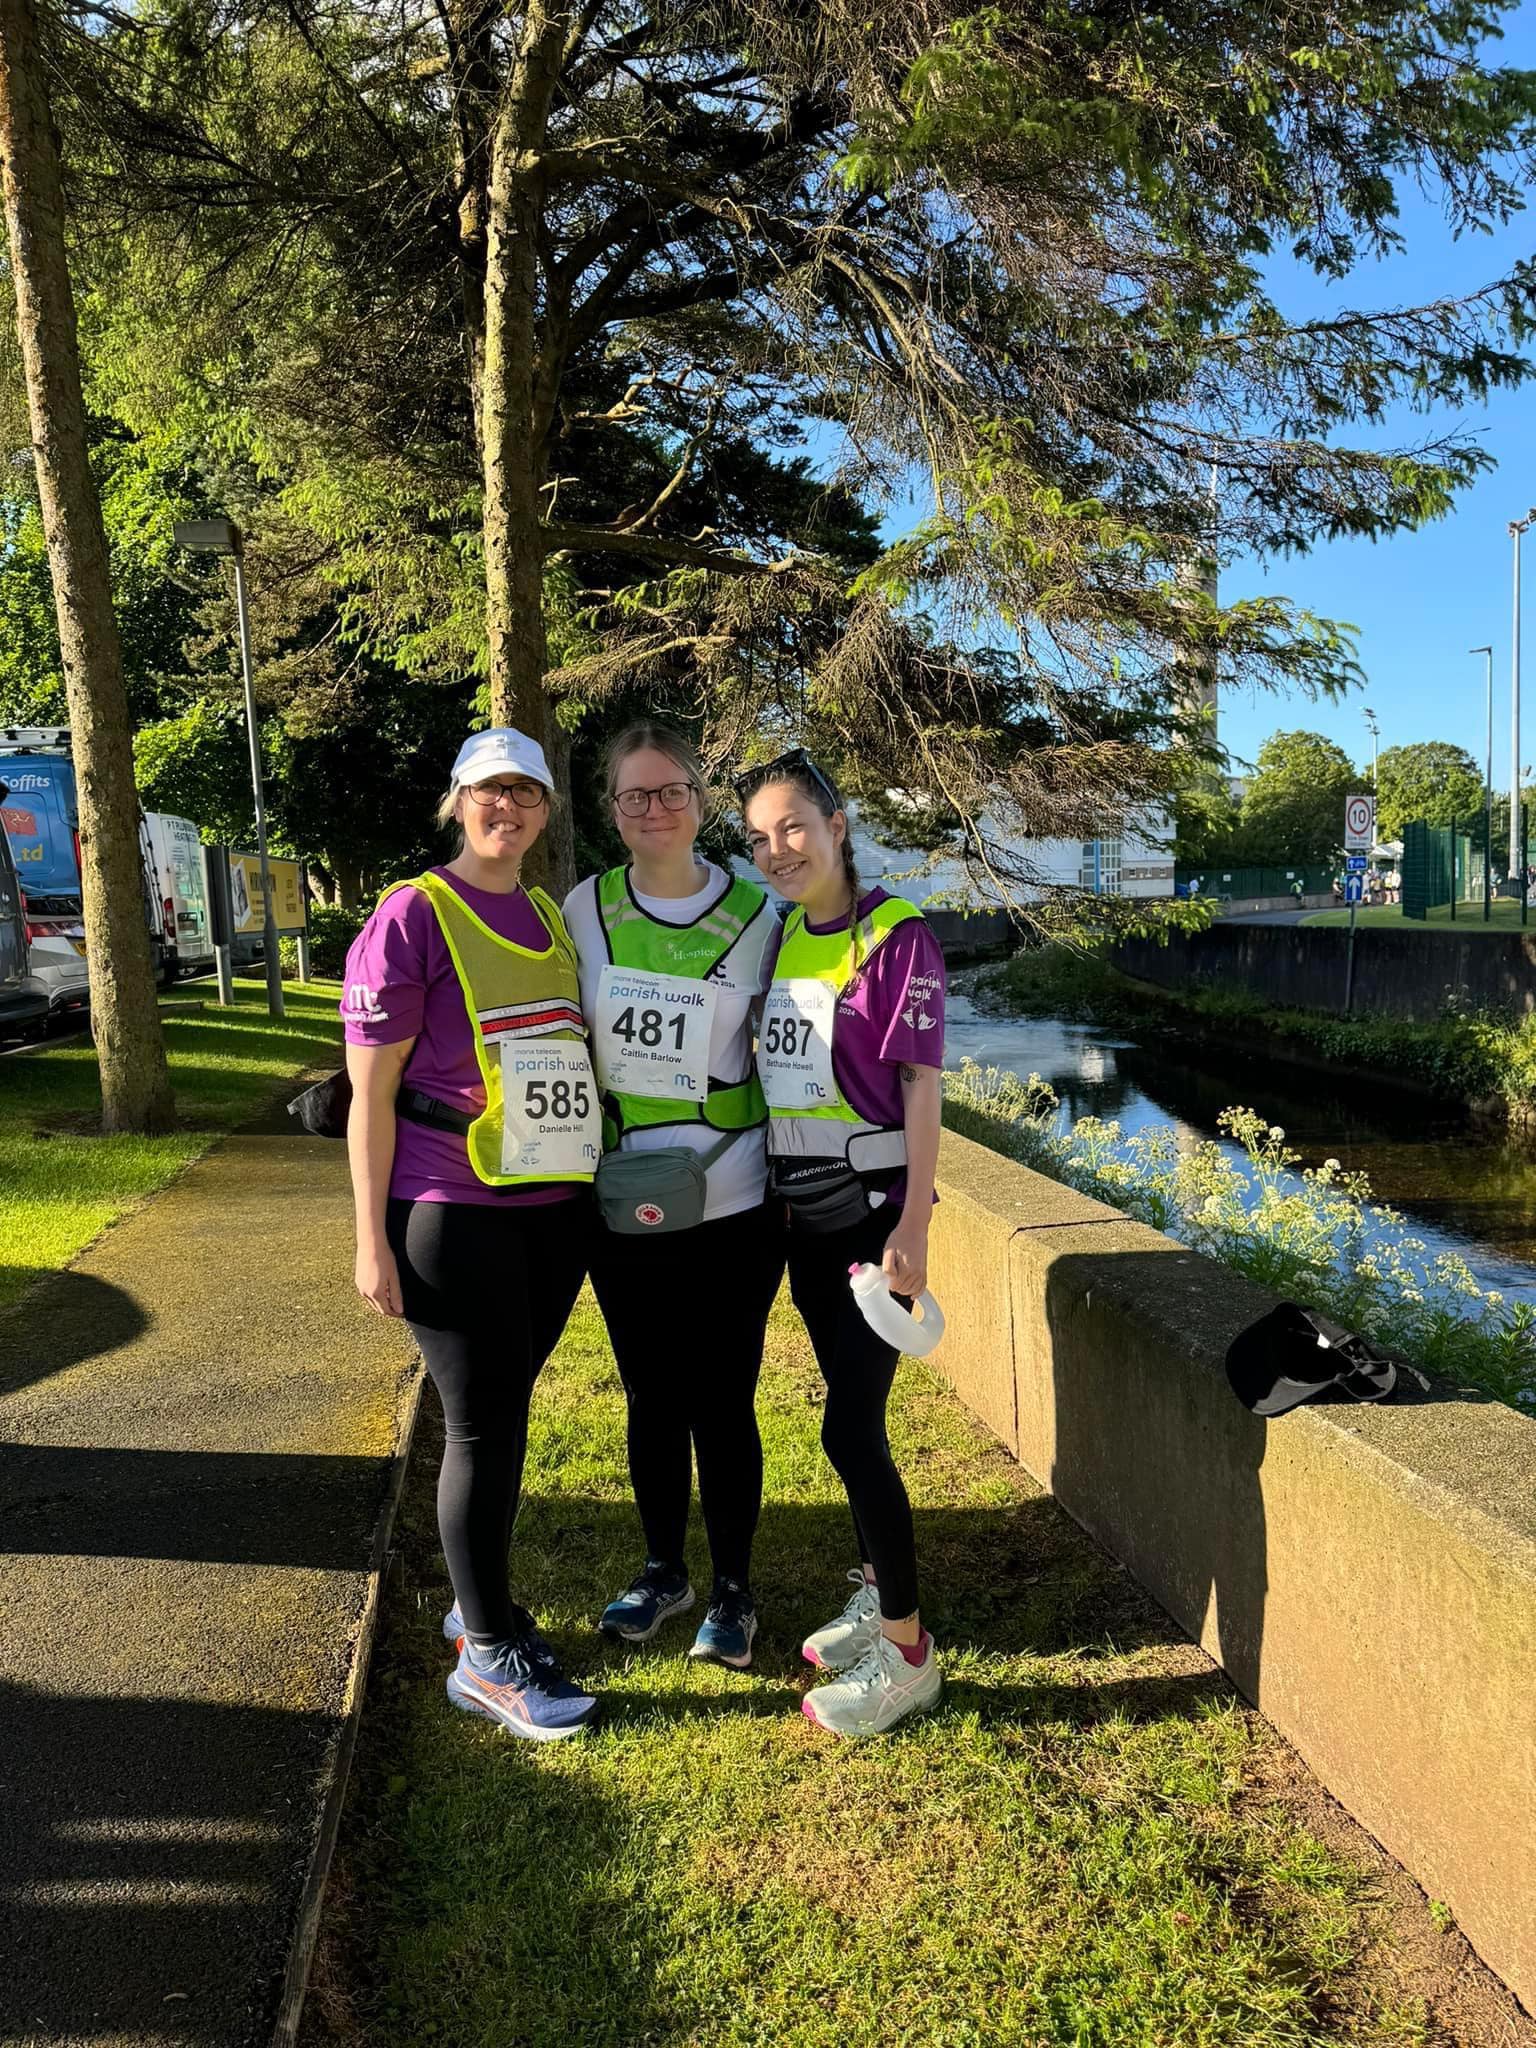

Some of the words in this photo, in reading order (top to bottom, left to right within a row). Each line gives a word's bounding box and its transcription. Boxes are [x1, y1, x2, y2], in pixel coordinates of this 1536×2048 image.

[0, 775, 50, 791] Soffits
[1353, 809, 1366, 824] 10
[910, 976, 941, 990] parish
[609, 985, 660, 1001] parish
[665, 991, 705, 1008] walk
[839, 1006, 857, 1017] 2024
[612, 1006, 687, 1050] 481
[765, 1017, 814, 1056] 587
[621, 1047, 649, 1060] Caitlin
[650, 1052, 682, 1064] Barlow
[515, 1056, 566, 1074] parish
[524, 1080, 590, 1120] 585
[539, 1124, 572, 1134] Danielle
